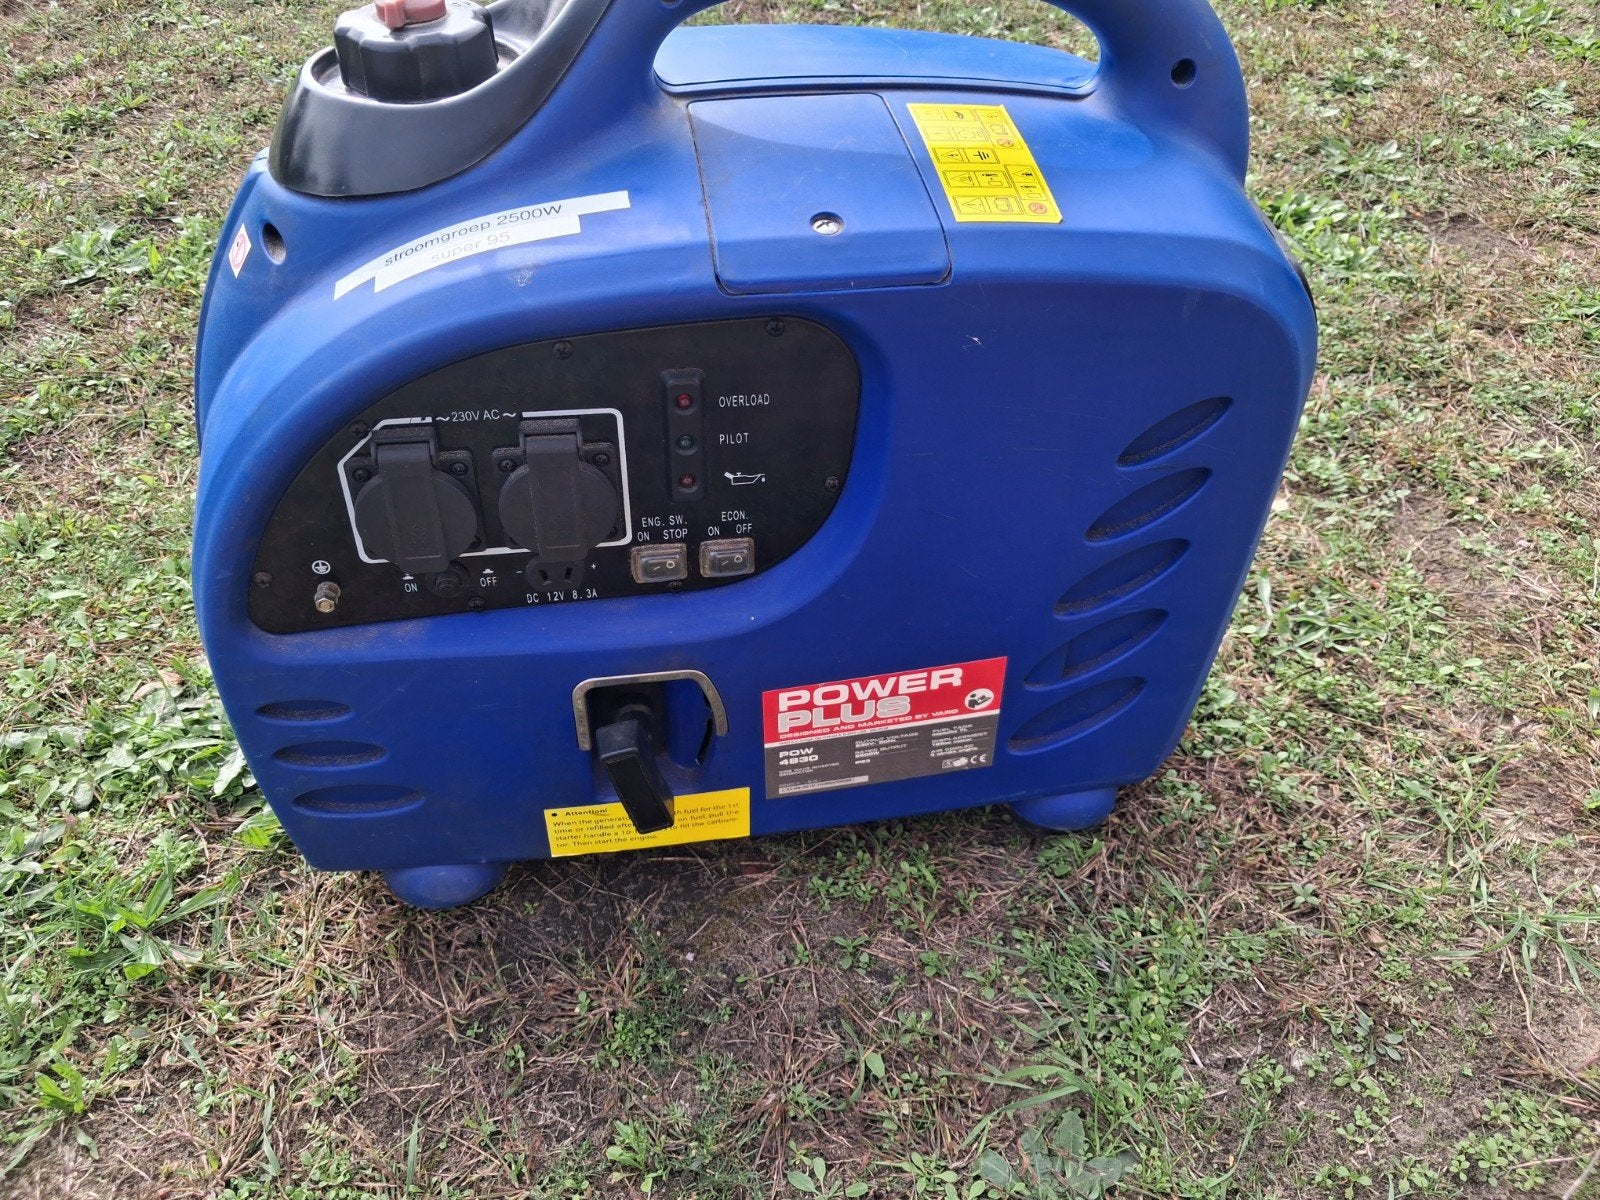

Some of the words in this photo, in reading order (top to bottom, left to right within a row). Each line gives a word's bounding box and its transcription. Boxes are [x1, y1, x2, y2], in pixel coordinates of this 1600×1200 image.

[384, 220, 491, 267] stroomgroep
[497, 204, 562, 226] 2500W
[431, 239, 481, 263] super
[487, 231, 511, 246] 95
[718, 393, 770, 408] OVERLOAD
[451, 410, 480, 422] 230V
[484, 409, 500, 420] AC
[719, 432, 749, 445] PILOT
[641, 516, 665, 528] ENG.
[668, 515, 688, 526] SW.
[721, 511, 749, 522] ECON.
[637, 530, 650, 542] ON
[663, 528, 688, 540] STOP
[707, 526, 720, 537] ON
[736, 523, 752, 534] OFF
[404, 582, 418, 593] ON
[479, 576, 498, 587] OFF
[526, 593, 539, 603] DC
[547, 591, 565, 602] 12V
[778, 667, 963, 712] POWER
[777, 695, 911, 733] PLUS
[779, 727, 831, 740] DESIGNED
[833, 723, 855, 732] AND
[858, 716, 912, 728] MARKETED
[931, 708, 960, 717] VARO
[779, 747, 814, 758] POW
[565, 808, 608, 816] Attention!
[555, 833, 581, 841] starter
[583, 831, 611, 839] handle
